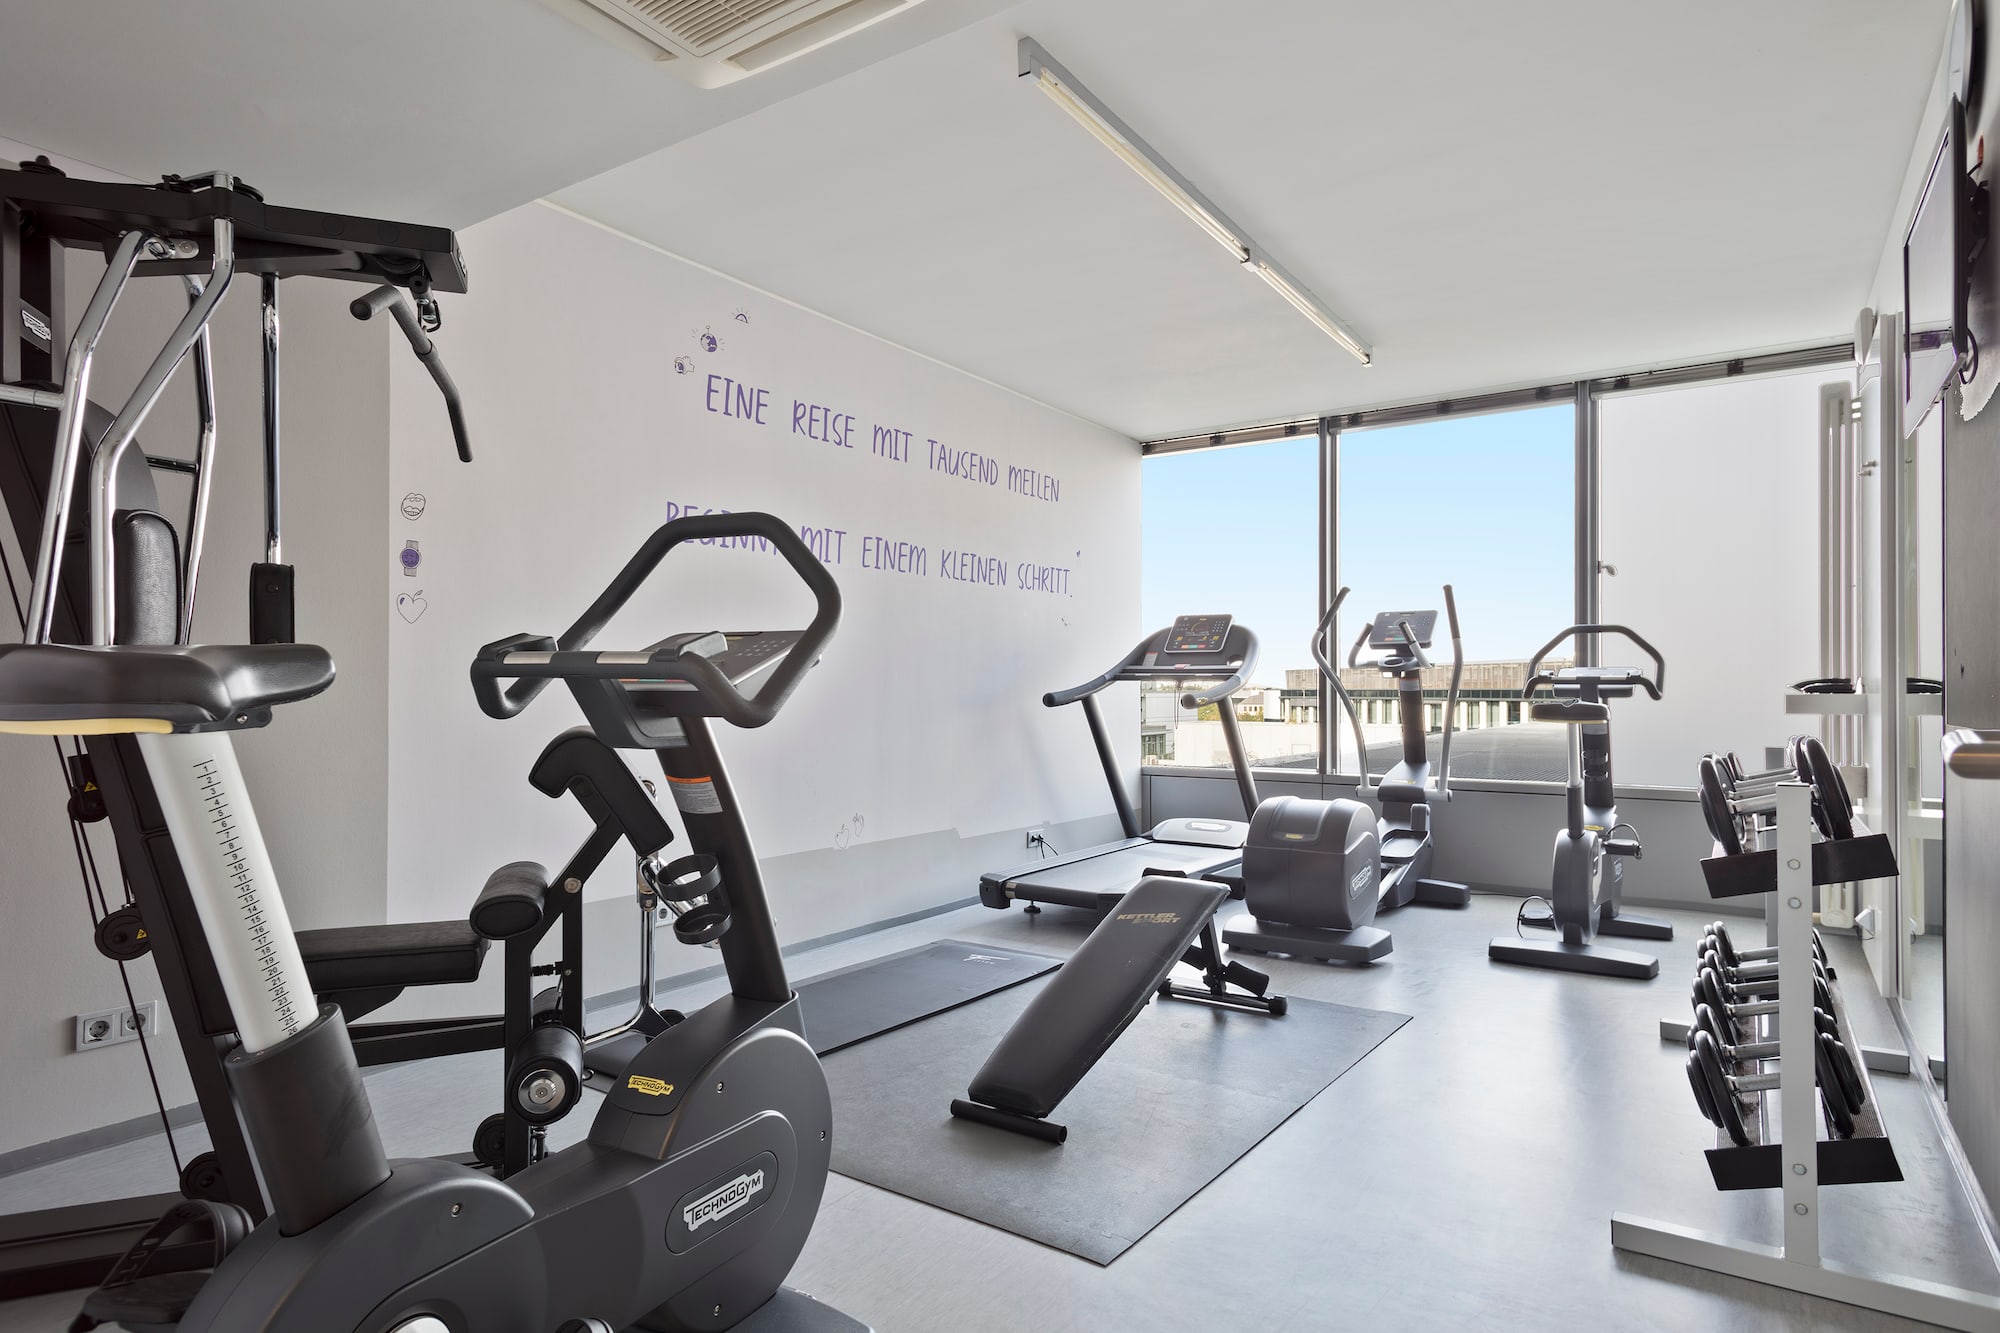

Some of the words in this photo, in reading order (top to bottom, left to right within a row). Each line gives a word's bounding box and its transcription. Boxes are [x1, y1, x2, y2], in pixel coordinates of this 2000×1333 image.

[706, 374, 769, 425] EINE
[793, 399, 856, 448] REISE
[873, 424, 913, 462] MIT
[927, 439, 999, 486] TAUSEND
[1008, 465, 1060, 502] MEILEN
[800, 525, 847, 564] MIT
[862, 536, 927, 576] EINEM
[940, 549, 1007, 586] KLEINEN
[1017, 563, 1073, 598] SCHRITT.
[206, 776, 213, 784] 2
[210, 787, 217, 795] 3
[218, 809, 224, 817] 5
[221, 820, 228, 828] 6
[225, 831, 230, 839] 7
[228, 842, 235, 850] 8
[232, 853, 238, 861] 9
[233, 862, 244, 872] 10
[237, 873, 247, 882] 11
[240, 884, 251, 893] 12
[244, 894, 254, 904] 13
[247, 905, 258, 914] 14
[250, 915, 261, 924] 15
[1117, 912, 1176, 920] KETTLER
[254, 925, 265, 935] 16
[257, 936, 267, 945] 17
[261, 946, 271, 955] 18
[264, 956, 274, 965] 19
[267, 966, 278, 976] 20
[271, 976, 281, 986] 21
[274, 986, 285, 997] 22
[277, 996, 288, 1007] 23
[280, 1006, 291, 1017] 24
[284, 1016, 295, 1026] 25
[287, 1026, 298, 1036] 26
[685, 1174, 762, 1226] TECHNOGYM
